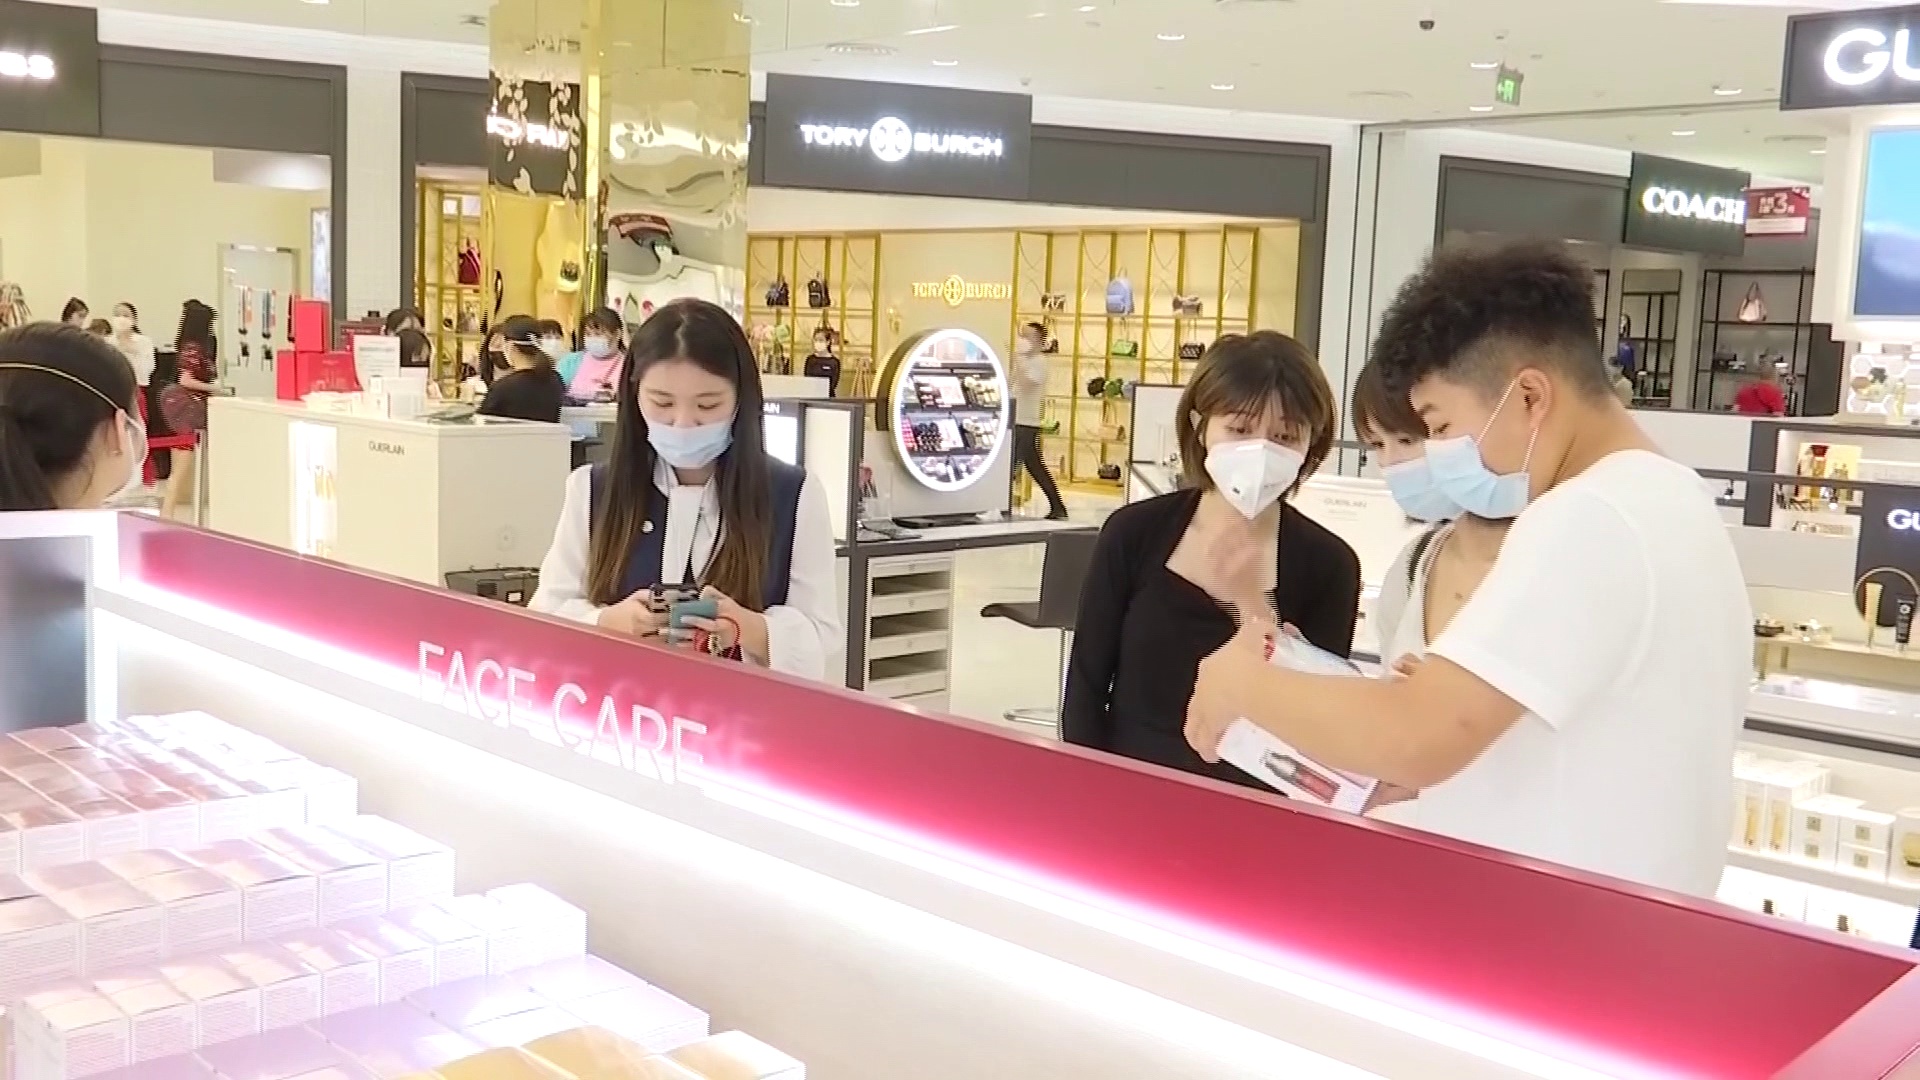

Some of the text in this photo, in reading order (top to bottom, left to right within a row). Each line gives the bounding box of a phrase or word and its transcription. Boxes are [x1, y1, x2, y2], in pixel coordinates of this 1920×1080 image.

[800, 124, 1003, 156] TORY BURCH
[1642, 186, 1746, 224] COACH
[912, 282, 1012, 300] TORY BURCH
[418, 640, 708, 788] FACE CARE
